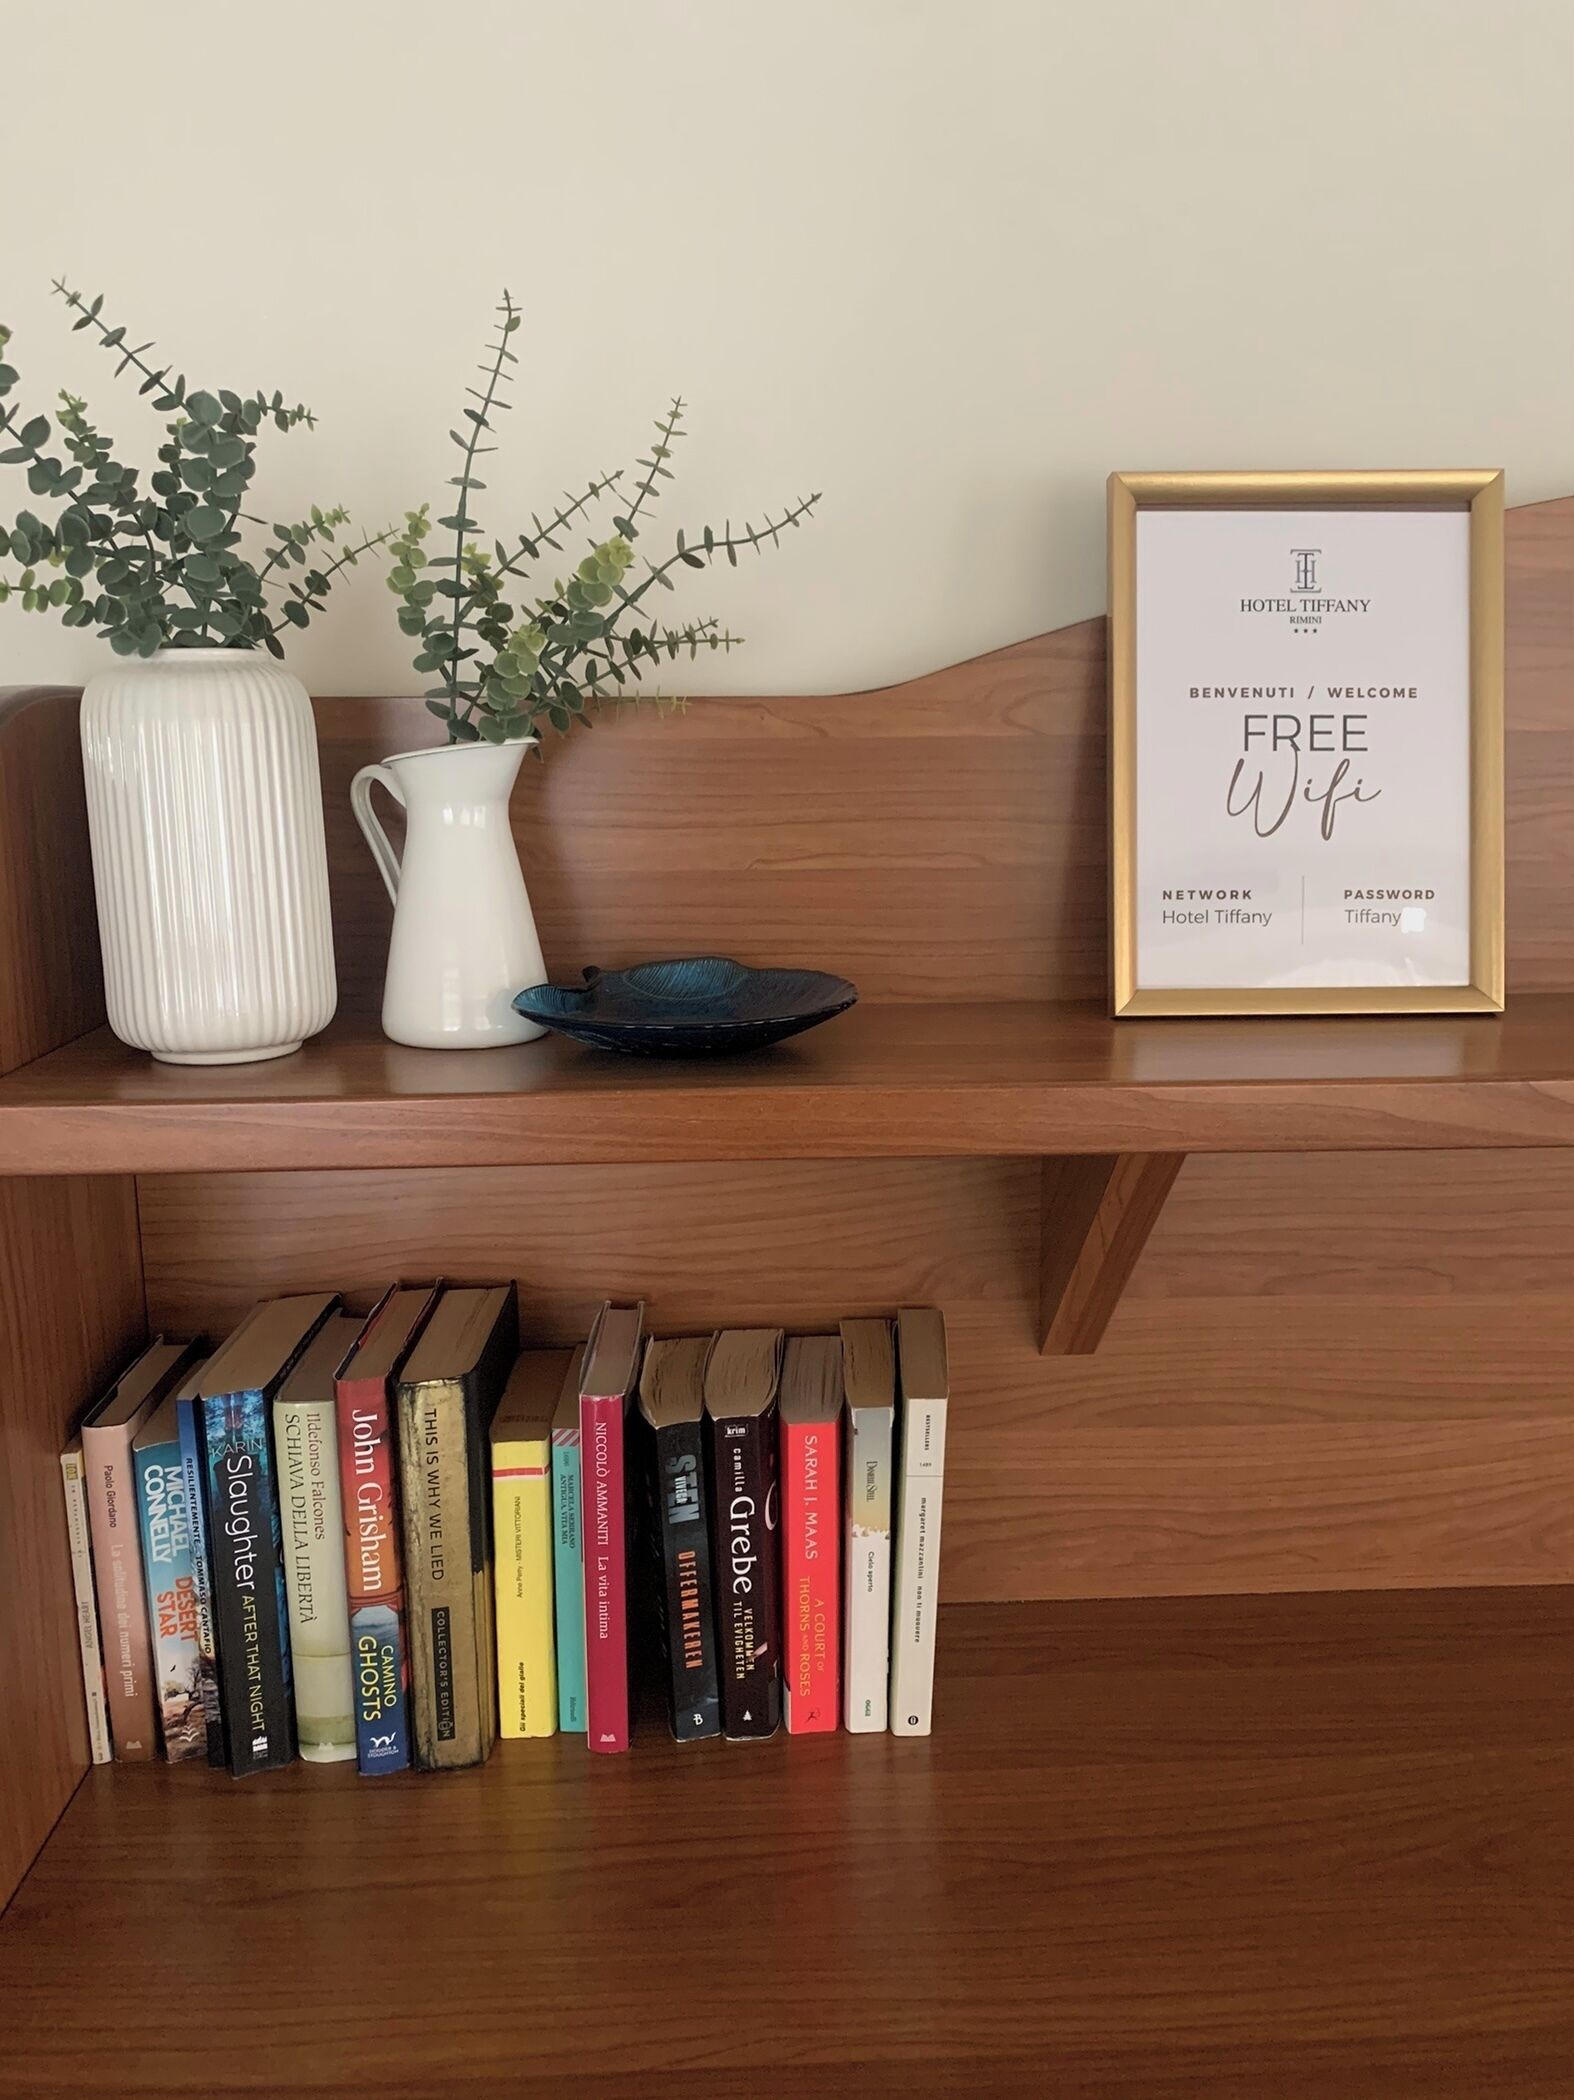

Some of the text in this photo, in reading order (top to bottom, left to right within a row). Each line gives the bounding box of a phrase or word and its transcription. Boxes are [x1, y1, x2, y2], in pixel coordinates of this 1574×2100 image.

[1240, 598, 1371, 613] HOTEL TIFFANY
[1289, 616, 1322, 624] RIMINI
[1189, 686, 1418, 700] BENVENUTI / WELCOME
[1243, 715, 1368, 752] FREE
[1226, 743, 1382, 841] Wifi
[1162, 890, 1252, 901] NETWORK
[1162, 908, 1272, 928] Hotel Tiffany
[1343, 889, 1436, 901] PASSWORD
[1344, 908, 1402, 928] Tiffany
[212, 1438, 263, 1458] KARIN
[727, 1426, 746, 1435] krim
[104, 1465, 118, 1528] Paolo Giordano
[305, 1412, 325, 1540] Ildefonso Falcones
[351, 1409, 387, 1592] John Grisham
[424, 1409, 445, 1581] THIS IS WHY WE LIED
[567, 1474, 575, 1511] MARCELA
[804, 1434, 818, 1560] SARAH J. MAAS
[143, 1464, 172, 1563] CONNELLY
[163, 1465, 190, 1556] MICHAEL
[225, 1454, 257, 1591] Slaughter
[284, 1414, 317, 1625] SCHIAVA DELLA LIBERTÀ
[595, 1422, 609, 1640] NICCOLÒ AMMANITI La vita intima
[730, 1448, 757, 1594] camilla Grebe
[918, 1497, 927, 1534] margaret
[185, 1457, 212, 1654] RESILIENTEMENTE TOMMASO CANTAFIO
[515, 1566, 524, 1581] Perry
[866, 1551, 875, 1593] Cielo aperto
[917, 1536, 925, 1579] mazzantini
[111, 1544, 138, 1697] La solitudine dei numeri primi
[156, 1591, 177, 1638] STAR
[175, 1576, 199, 1642] DESERT
[241, 1594, 259, 1643] AFTER
[677, 1551, 703, 1670] OFFERMAKEREN
[799, 1576, 811, 1632] THORNS
[814, 1599, 825, 1609] A
[914, 1610, 922, 1643] muovere
[436, 1611, 448, 1687] COLLECTOR'S
[733, 1602, 746, 1680] TIL EVIGHETEN
[814, 1611, 826, 1659] COURT
[246, 1642, 262, 1679] THAT
[357, 1635, 382, 1721] GHOSTS
[380, 1644, 397, 1708] CAMINO
[799, 1652, 811, 1697] ROSES
[249, 1680, 266, 1731] NIGHT
